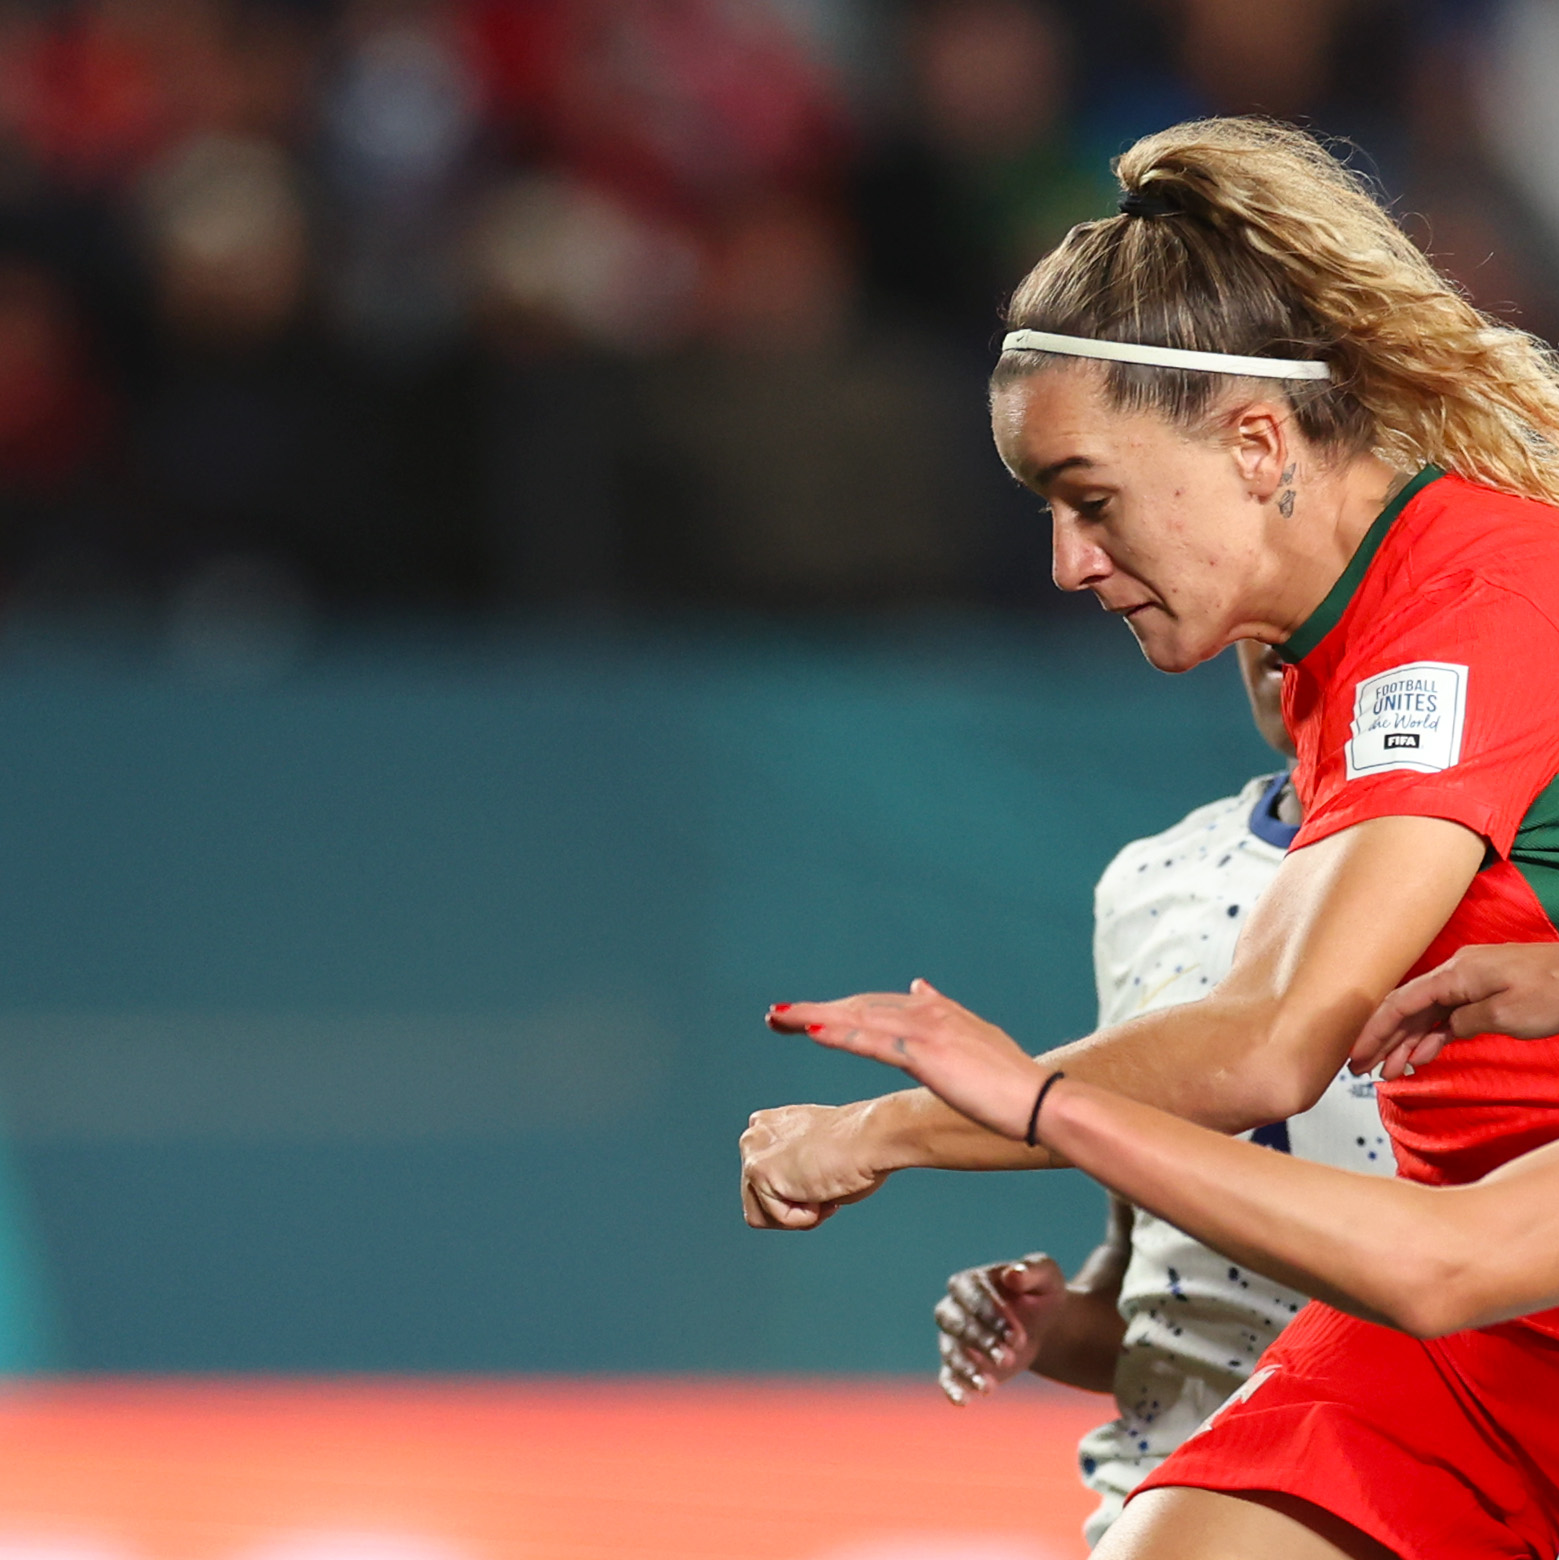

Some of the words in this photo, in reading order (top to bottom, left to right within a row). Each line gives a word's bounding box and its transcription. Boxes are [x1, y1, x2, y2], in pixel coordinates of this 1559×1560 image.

[1375, 679, 1438, 698] FOOTBALL
[1372, 694, 1437, 715] UNITES
[1394, 713, 1441, 733] World
[1387, 736, 1417, 747] FIFA
